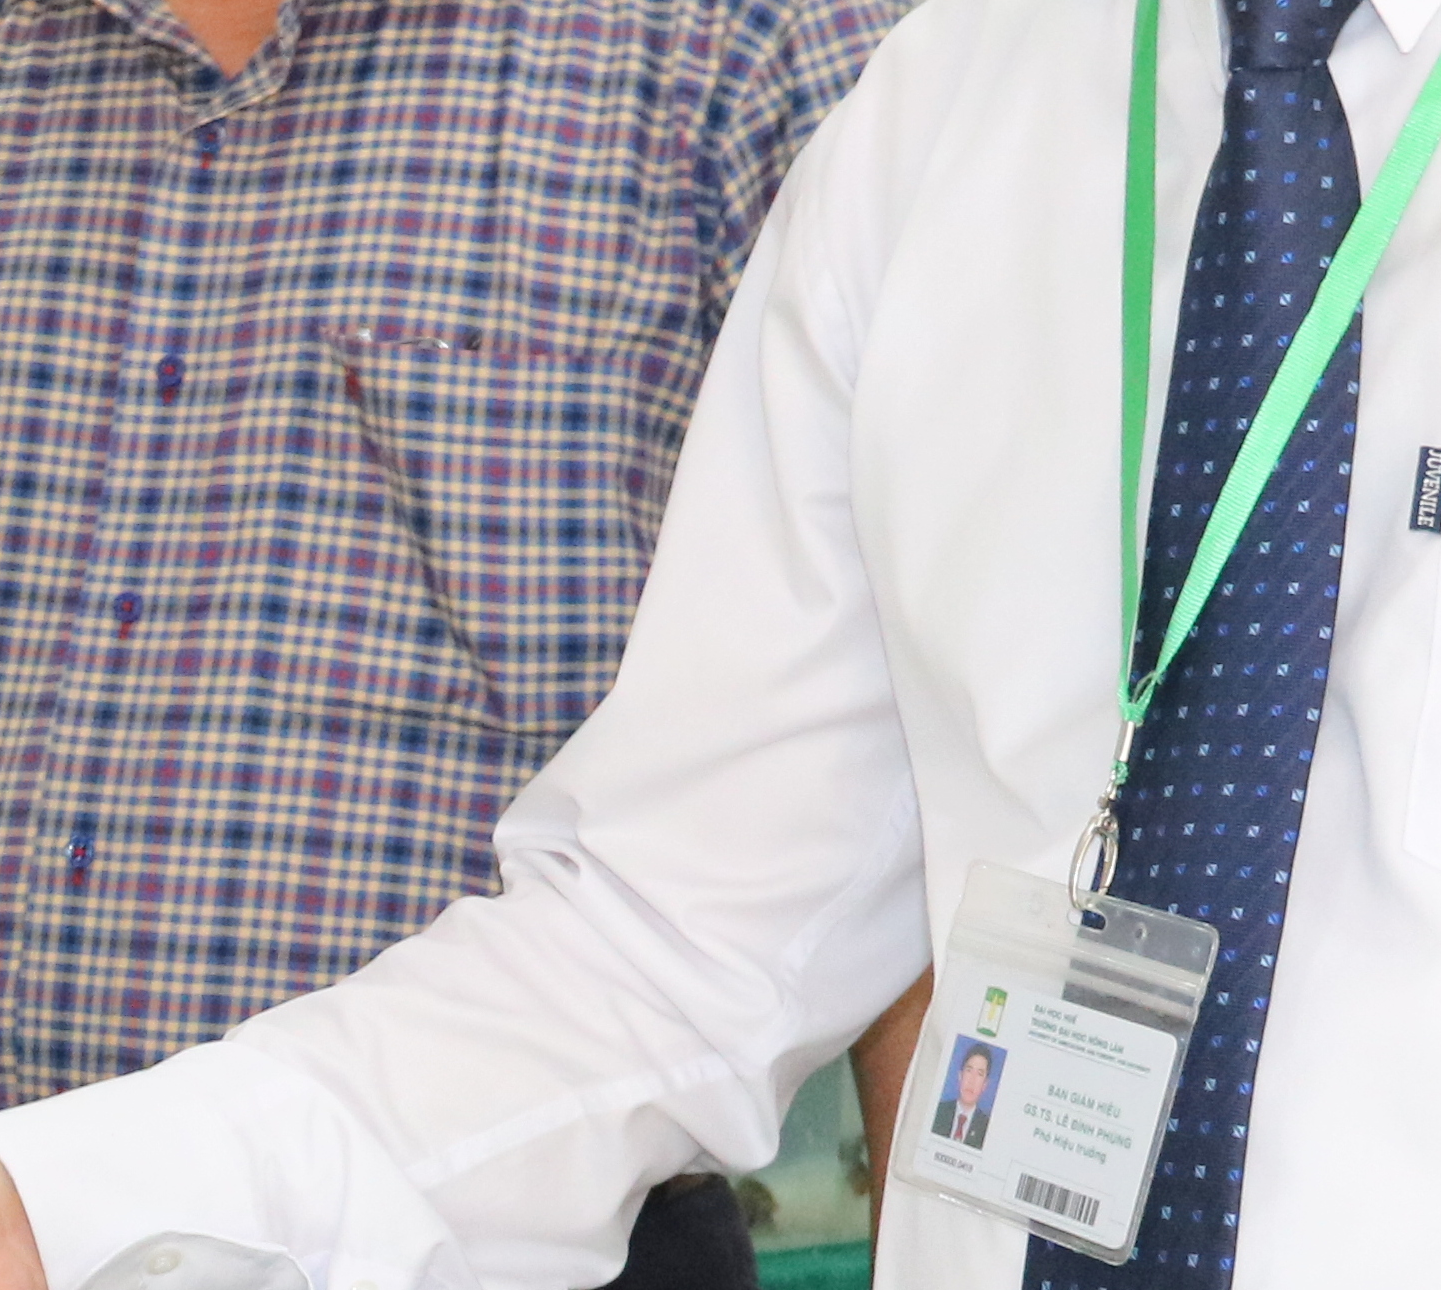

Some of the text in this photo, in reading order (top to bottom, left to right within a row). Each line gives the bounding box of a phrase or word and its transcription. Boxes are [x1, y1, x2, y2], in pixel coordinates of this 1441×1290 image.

[1047, 1084, 1069, 1101] BAN
[1055, 1112, 1069, 1129] LÊ
[1032, 1126, 1051, 1143] Phó
